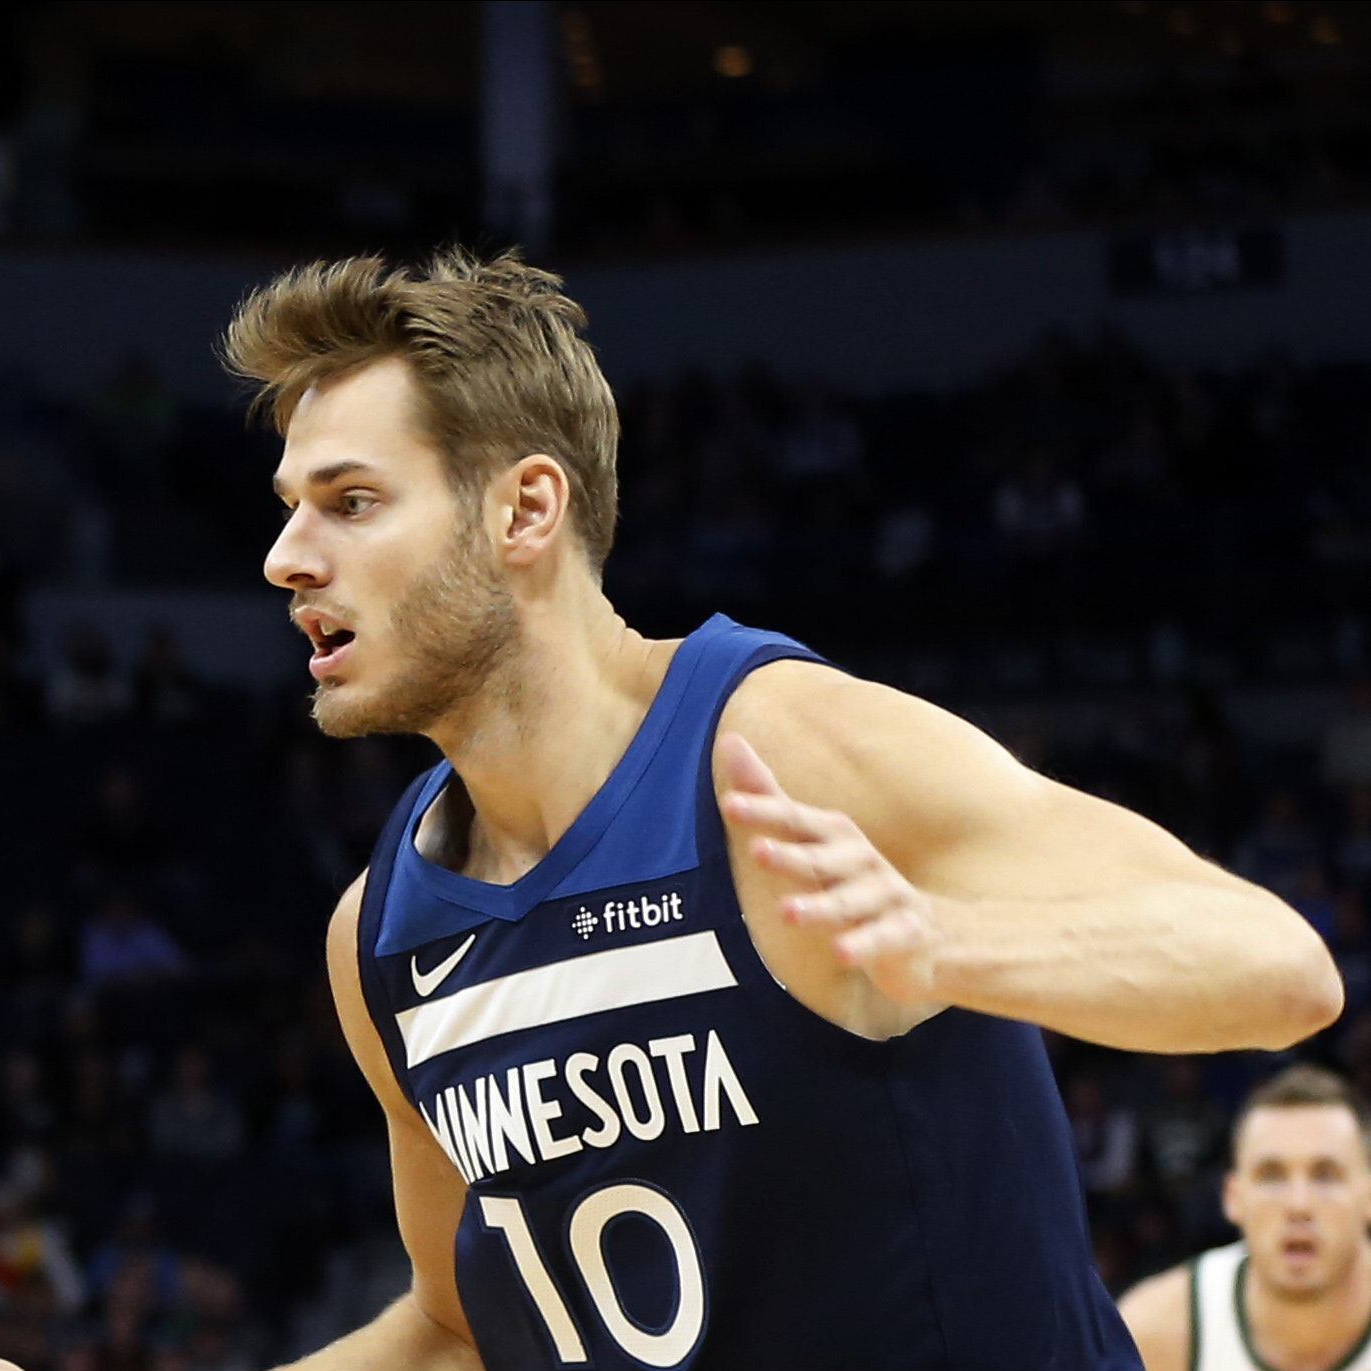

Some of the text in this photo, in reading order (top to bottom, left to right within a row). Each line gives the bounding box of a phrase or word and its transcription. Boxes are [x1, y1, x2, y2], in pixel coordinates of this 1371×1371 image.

[603, 892, 683, 933] fitbit
[418, 1029, 760, 1186] MINNESOTA
[479, 1183, 706, 1369] 10
